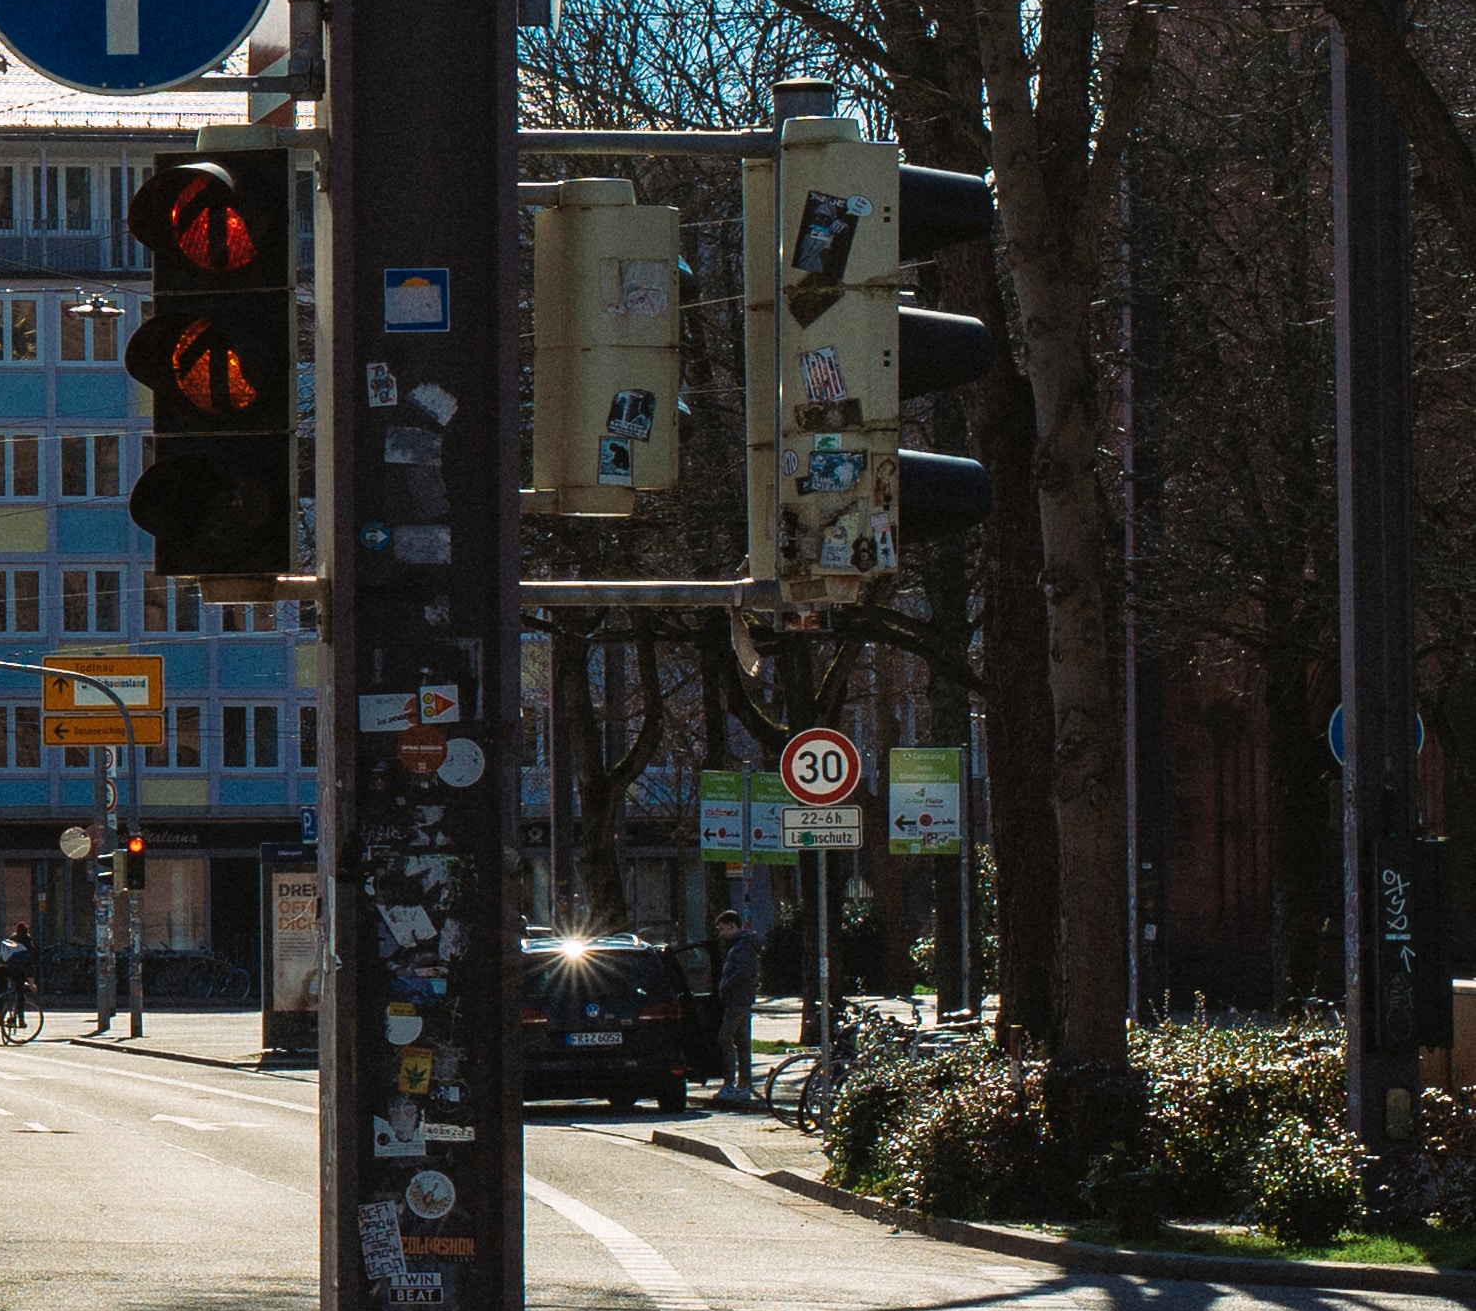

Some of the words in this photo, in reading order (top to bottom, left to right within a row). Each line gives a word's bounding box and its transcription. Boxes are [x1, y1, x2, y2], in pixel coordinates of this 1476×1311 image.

[74, 662, 115, 673] Todtnau
[74, 726, 127, 737] Donauesching
[798, 750, 843, 784] 30
[791, 831, 852, 844] Lämschutz
[572, 1034, 583, 1043] FR
[597, 1033, 621, 1043] 6052
[397, 1274, 434, 1285] TWIN
[397, 1290, 434, 1301] BEAT
